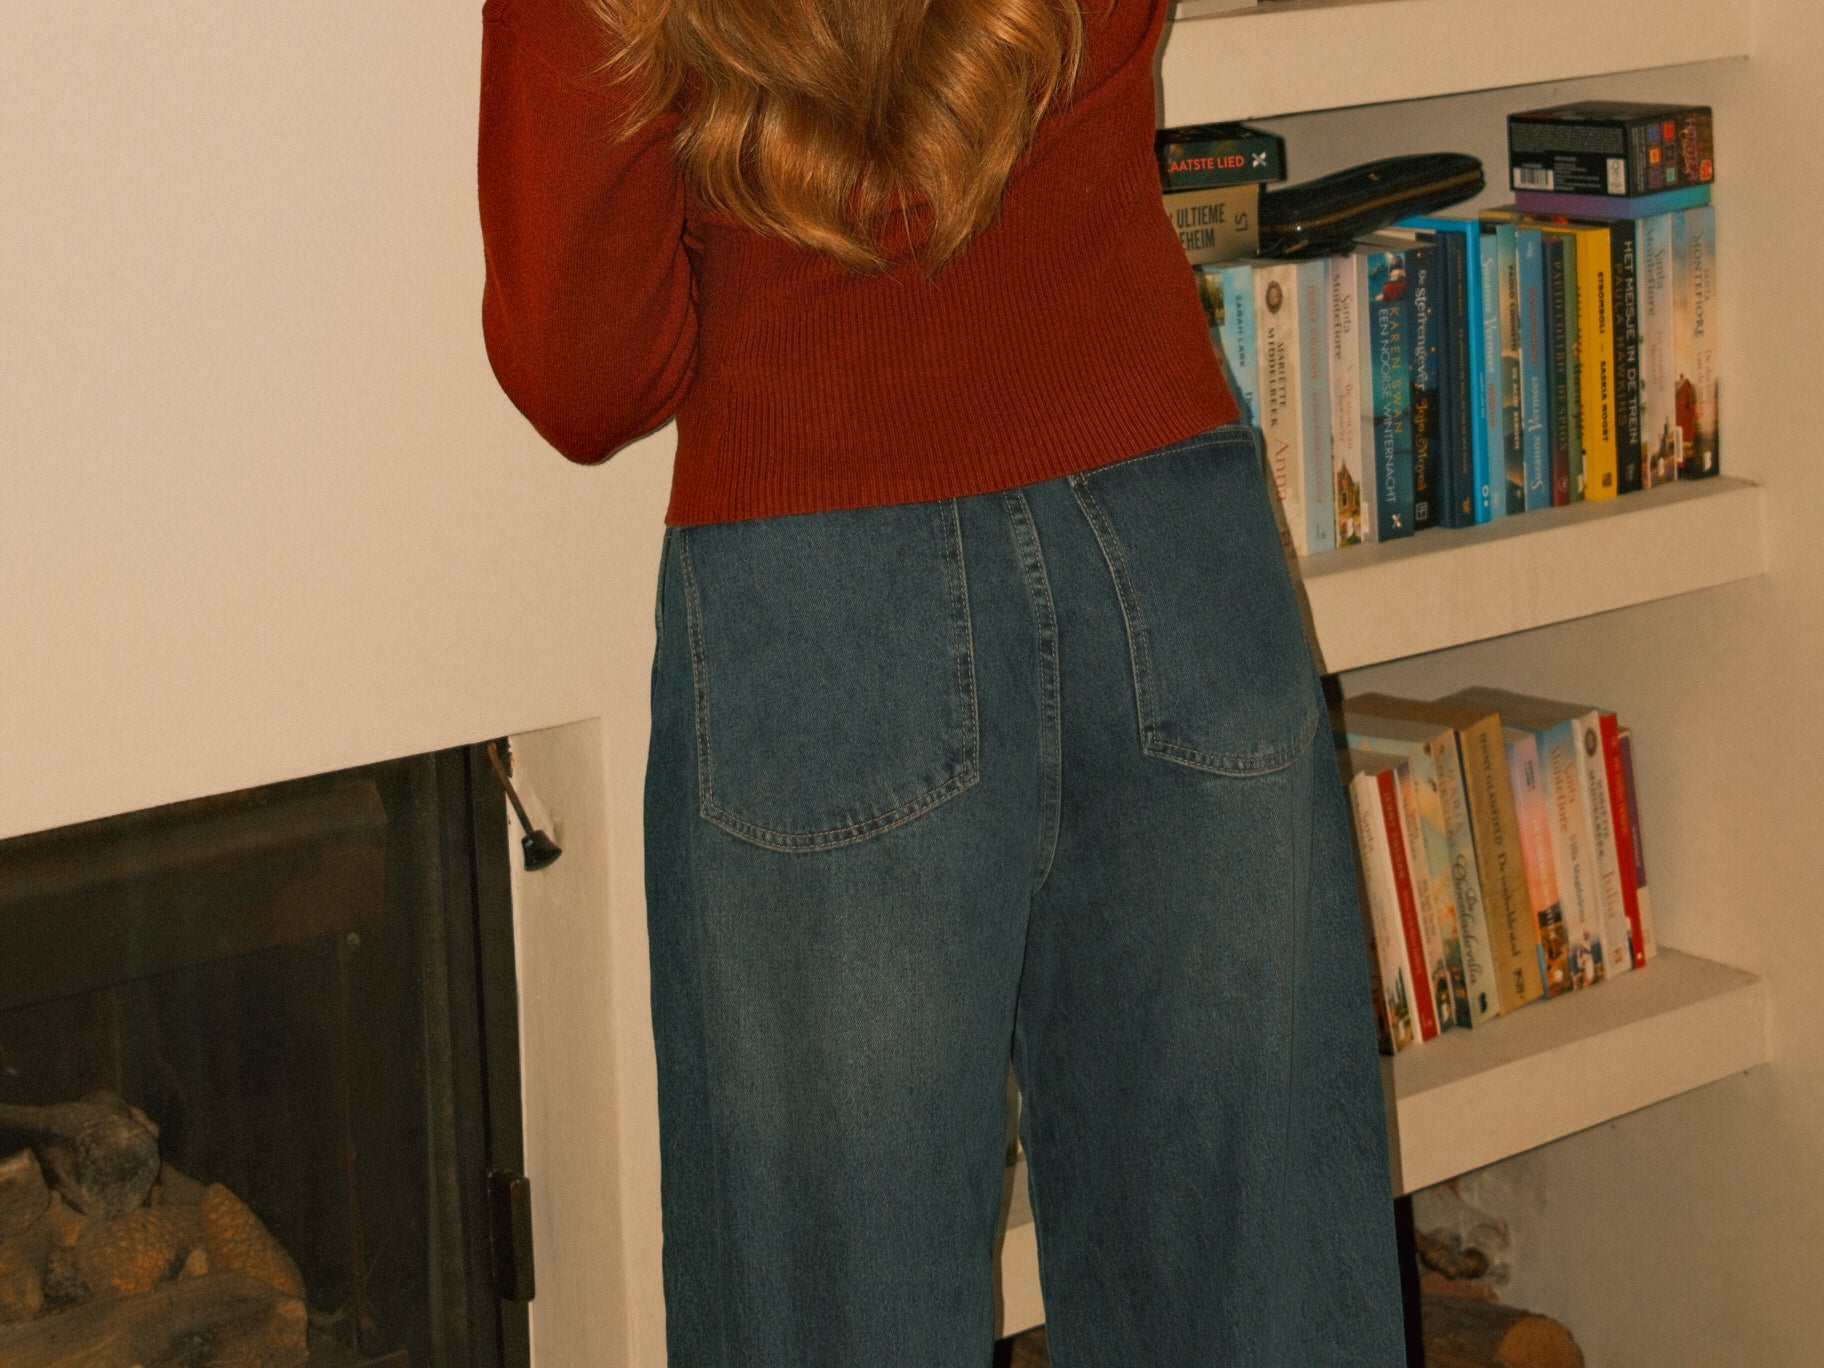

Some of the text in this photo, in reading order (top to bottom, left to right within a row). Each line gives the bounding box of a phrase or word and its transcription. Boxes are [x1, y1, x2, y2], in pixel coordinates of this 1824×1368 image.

[1168, 155, 1245, 173] AATSTE LIED
[1176, 203, 1226, 229] ULTIEME
[1480, 255, 1495, 313] Suzanne
[1508, 264, 1518, 352] PAOLO COGNETTI
[1645, 227, 1658, 317] Montefiore
[1692, 233, 1705, 339] MONTEFIORE
[1235, 294, 1246, 368] SARAH LARK
[1332, 273, 1353, 360] Santa Montefiore
[1414, 287, 1429, 391] sterrengever
[1483, 316, 1499, 374] Vermeer
[1597, 271, 1610, 442] STROMBOLI SASKIA NOORT
[1614, 262, 1627, 427] PAULA HAWKINS
[1623, 240, 1639, 444] HET MEISJE IN DE TREIN
[1267, 327, 1289, 429] MARIËTTE MIDDELBEEK
[1378, 308, 1397, 505] EEN NOORSE WINTERNACHT
[1389, 306, 1403, 435] KAREN SWAN
[1527, 375, 1543, 432] Vermeer
[1414, 398, 1429, 432] Jojo
[1273, 438, 1290, 502] Anna
[1415, 434, 1428, 492] Moyes
[1530, 435, 1546, 493] Suzanne
[1478, 732, 1491, 772] JENNY
